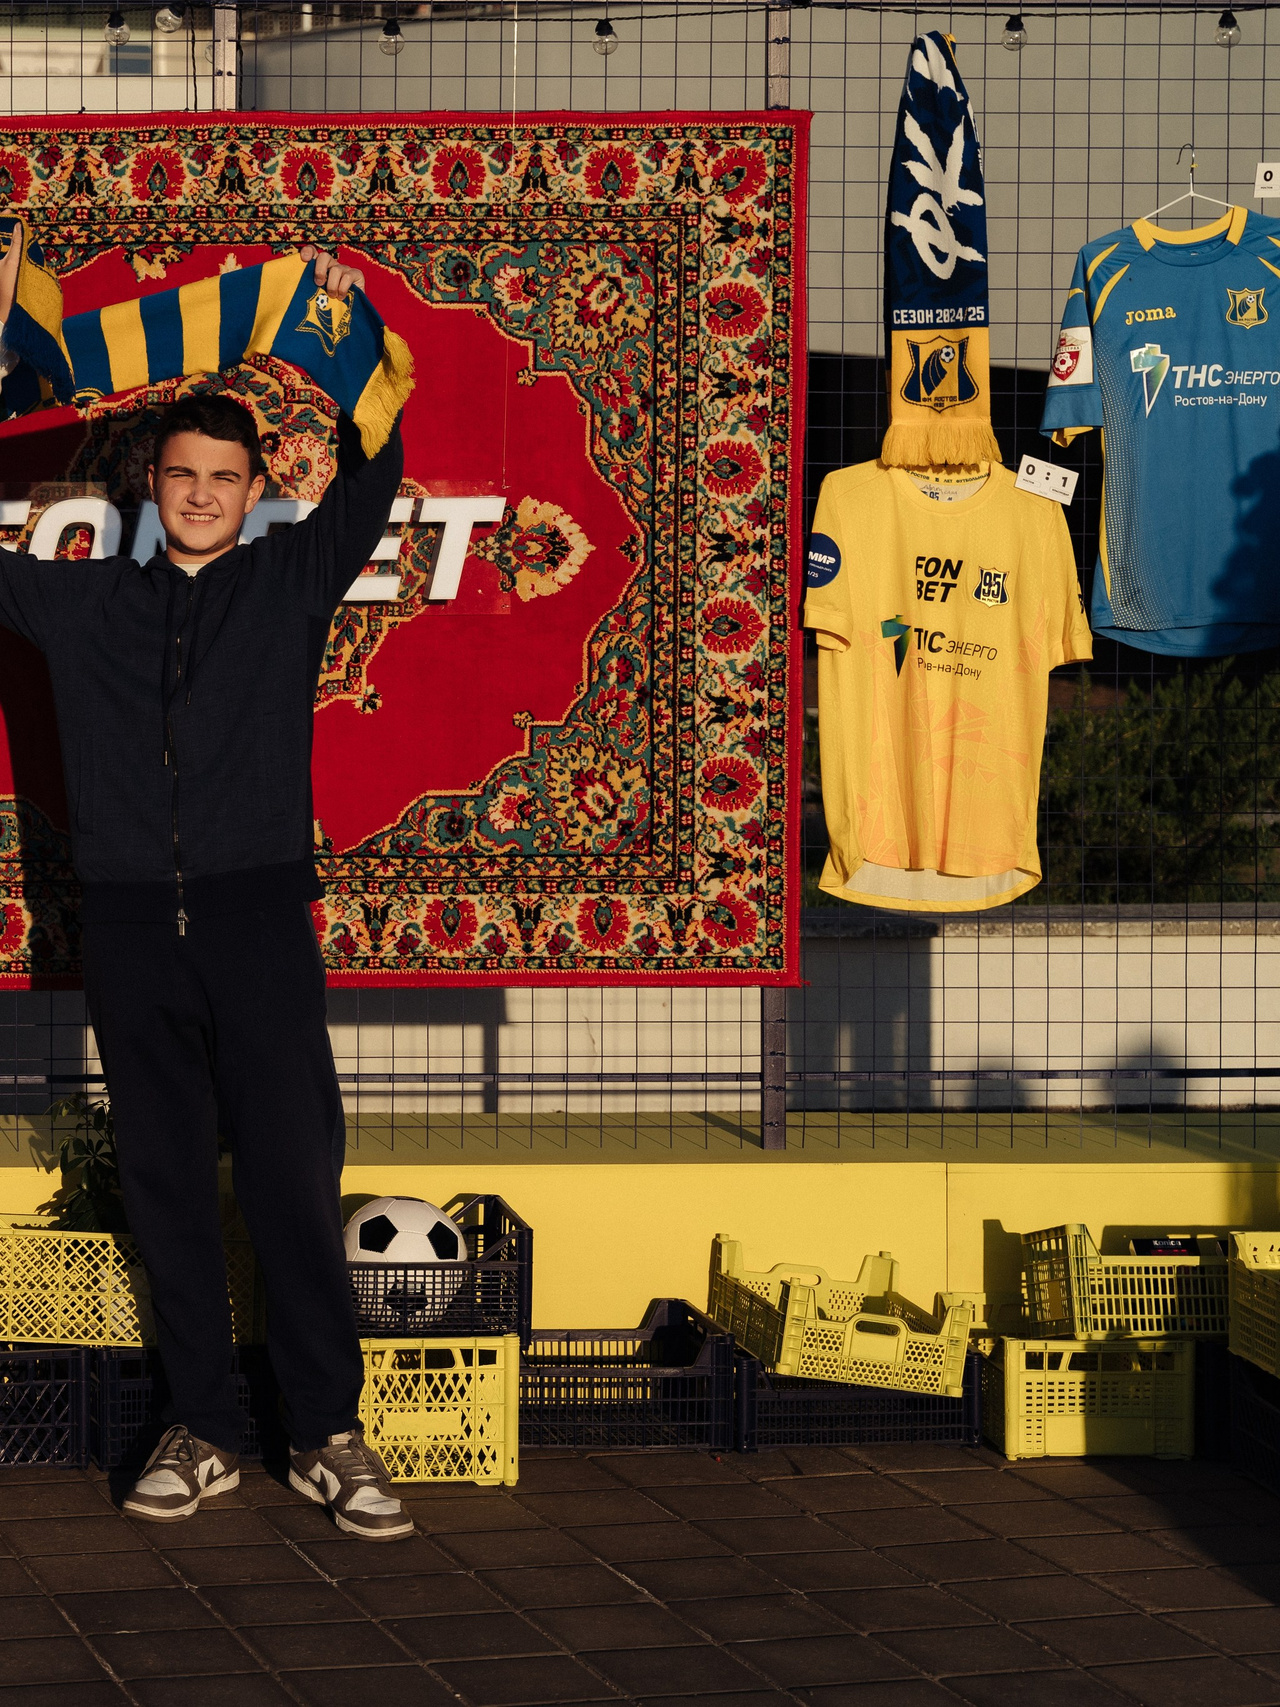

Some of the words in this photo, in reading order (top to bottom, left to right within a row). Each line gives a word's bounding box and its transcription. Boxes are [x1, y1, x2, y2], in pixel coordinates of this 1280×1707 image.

[1263, 170, 1274, 182] 0
[892, 309, 934, 324] СЕЗОН
[935, 306, 985, 323] 2024/25
[1171, 364, 1223, 389] ТНС
[1174, 392, 1268, 408] Ростов-на-Дону
[1026, 464, 1036, 476] 0
[1061, 476, 1069, 488] 1
[915, 556, 964, 580] FON
[916, 580, 958, 603] BET
[913, 627, 946, 653] ТС
[945, 640, 998, 661] ЭНЕРГО
